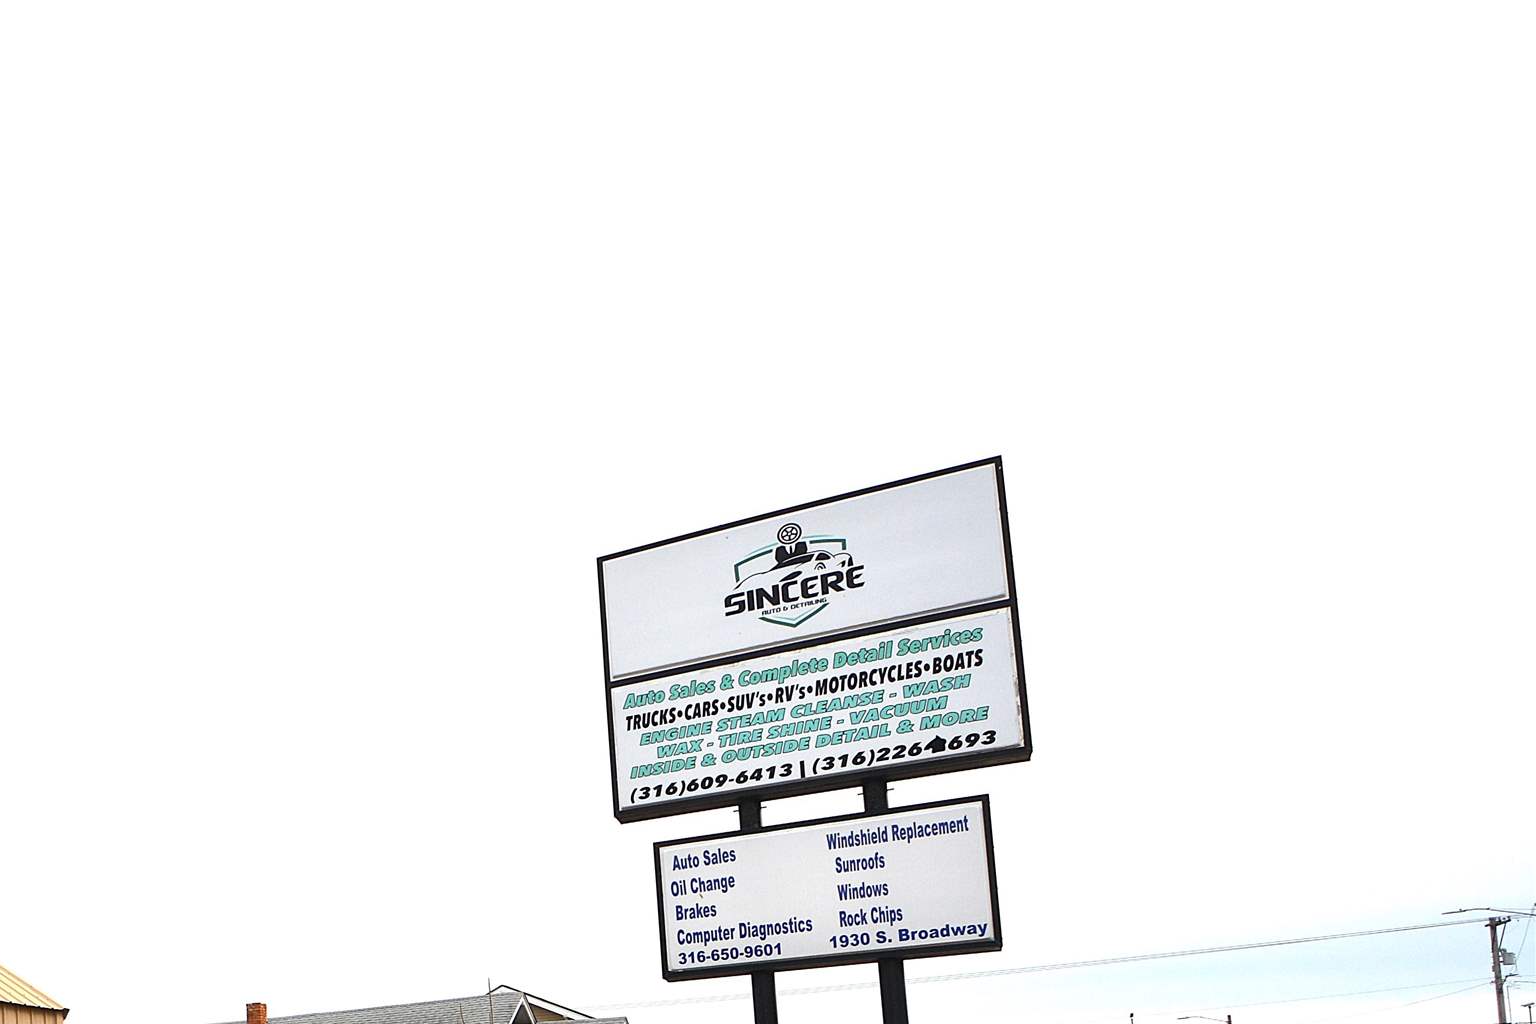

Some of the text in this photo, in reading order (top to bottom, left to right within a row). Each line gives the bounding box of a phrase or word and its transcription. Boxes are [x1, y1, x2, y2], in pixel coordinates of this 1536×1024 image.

[724, 565, 865, 616] SINCERE
[762, 607, 782, 616] AUTO
[791, 597, 827, 610] DETAILING
[623, 628, 983, 709] Auto Sales & Complete Detail Services
[640, 721, 712, 746] ENGINE
[716, 708, 785, 732] STEAM
[791, 690, 884, 717] CLEANSE
[903, 674, 971, 698] WASH
[657, 739, 704, 758] WAX
[718, 728, 763, 748] TIRE
[767, 716, 832, 739] SHINE
[849, 696, 948, 725] VACUUM
[630, 706, 989, 779] INSIDE & OUTSIDE DETAIL & MORE
[630, 763, 793, 803] (316)609-6413
[826, 815, 969, 850] Windshield Replacement
[672, 848, 736, 871] Auto Sales
[835, 852, 885, 874] Sunroofs
[671, 875, 735, 897] Oil Change
[837, 882, 889, 901] Windows
[676, 903, 716, 921] Brakes
[839, 906, 903, 928] Rock Chips
[677, 917, 813, 946] Computer Diagnostics
[829, 923, 988, 949] 1930 S. Broadway
[678, 942, 782, 965] 316-650-9601
